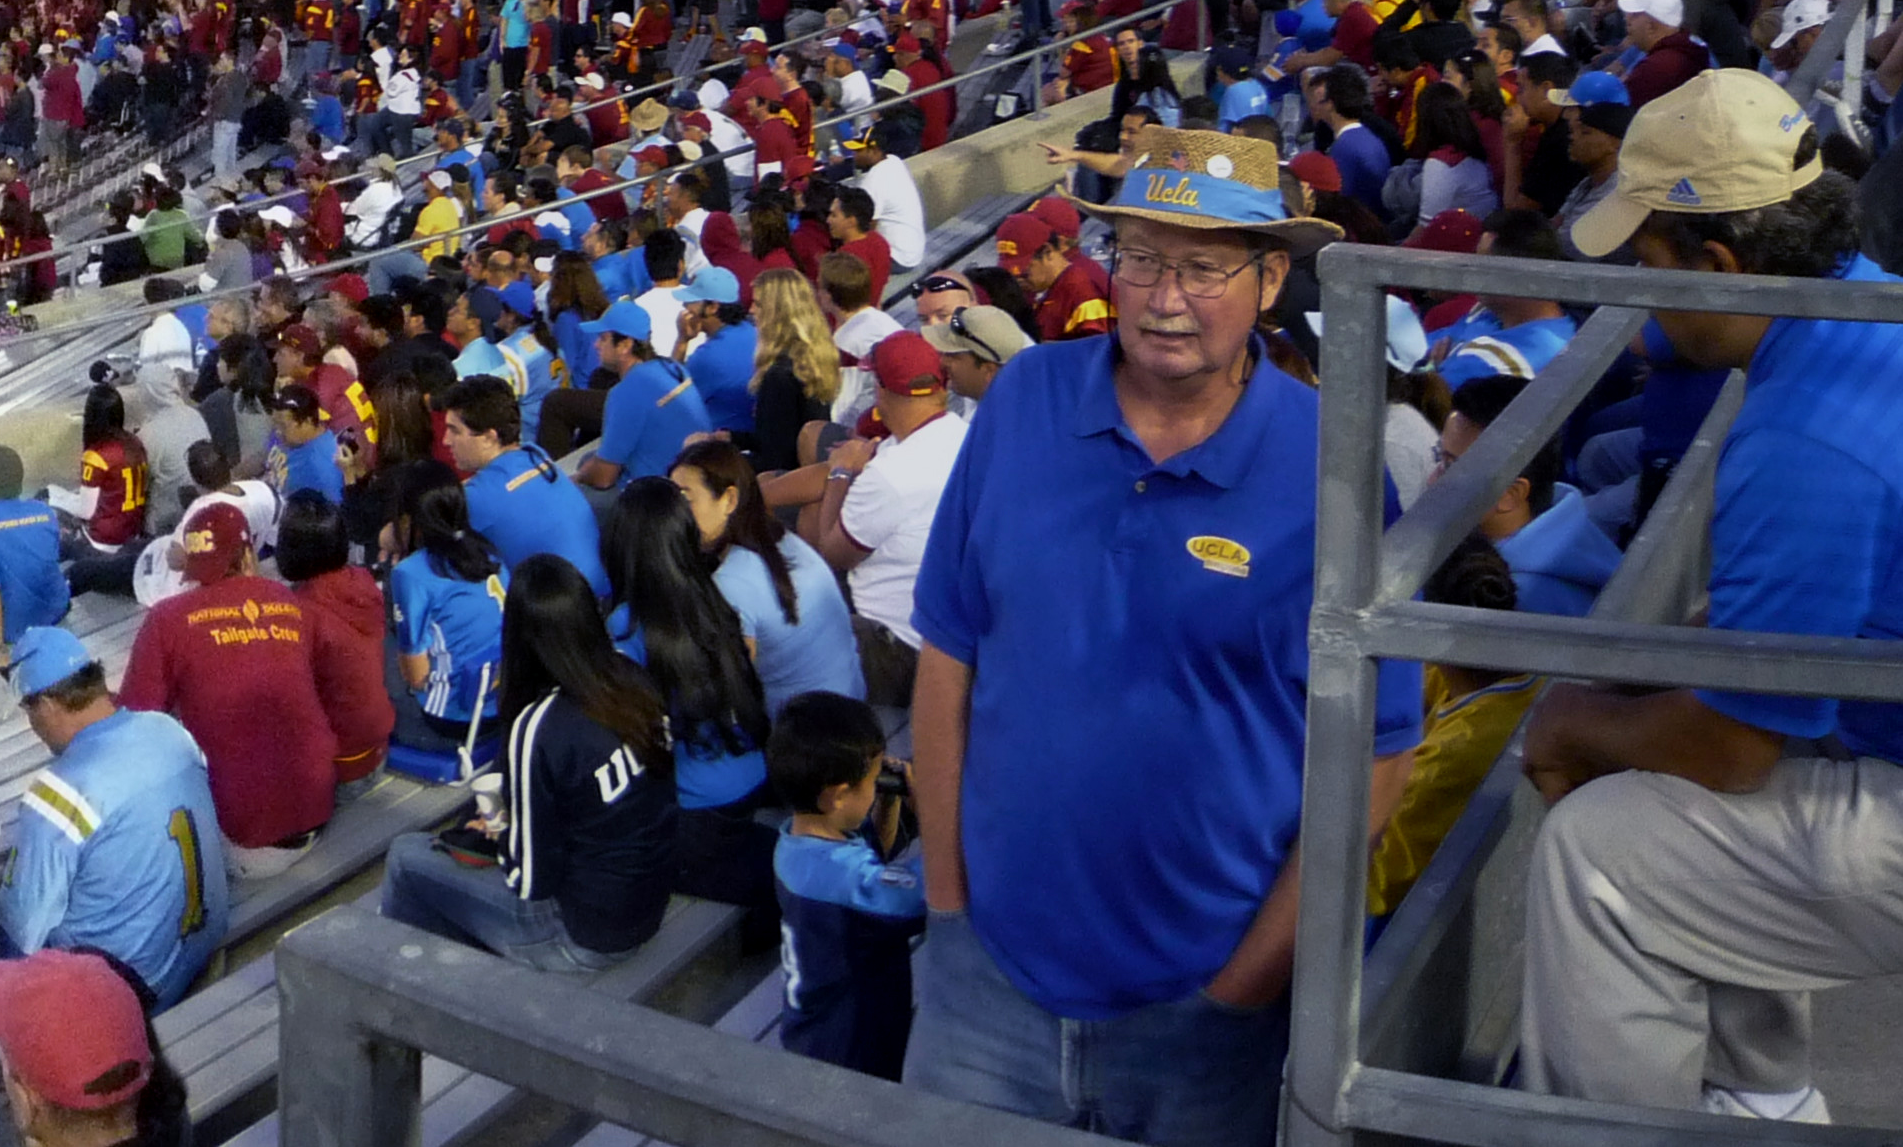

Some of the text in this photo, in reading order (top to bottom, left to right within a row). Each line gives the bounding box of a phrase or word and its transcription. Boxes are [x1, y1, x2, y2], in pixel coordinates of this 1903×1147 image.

[1146, 173, 1199, 206] Ucla
[1192, 540, 1243, 562] UCLA
[188, 607, 241, 624] NATIONAL
[211, 620, 301, 645] Tailgate Crew
[167, 806, 209, 938] 1
